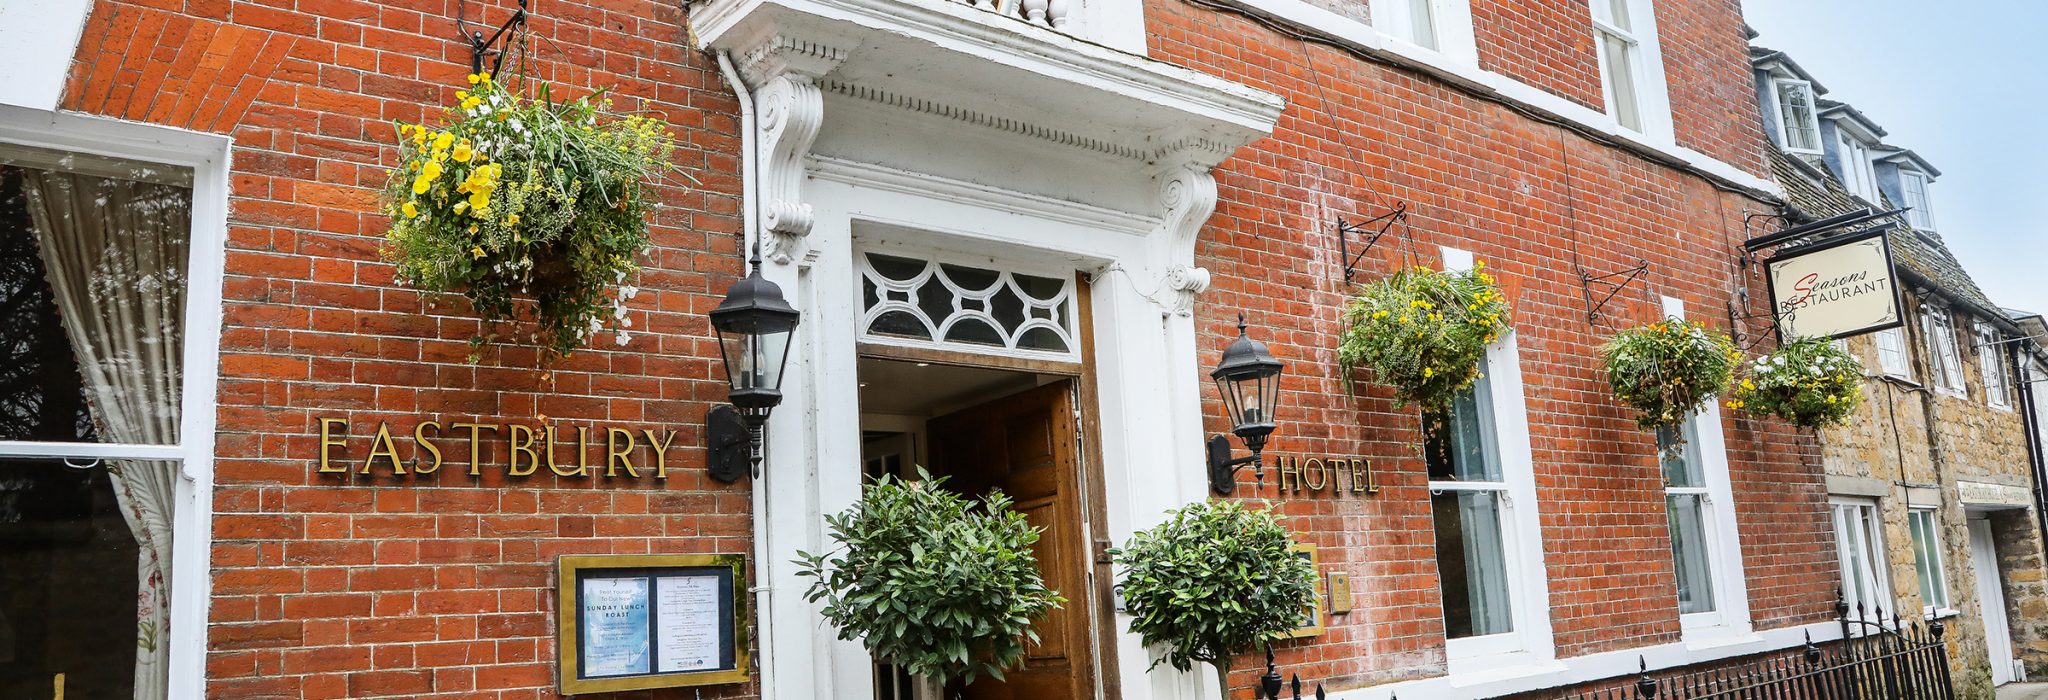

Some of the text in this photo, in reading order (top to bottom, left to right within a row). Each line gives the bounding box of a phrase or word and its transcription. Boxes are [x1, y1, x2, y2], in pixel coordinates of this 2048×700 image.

[1780, 278, 1886, 313] RESTAURANT
[1787, 270, 1867, 307] Seasons
[318, 417, 677, 479] EASTBURY
[1278, 456, 1379, 493] HOTEL
